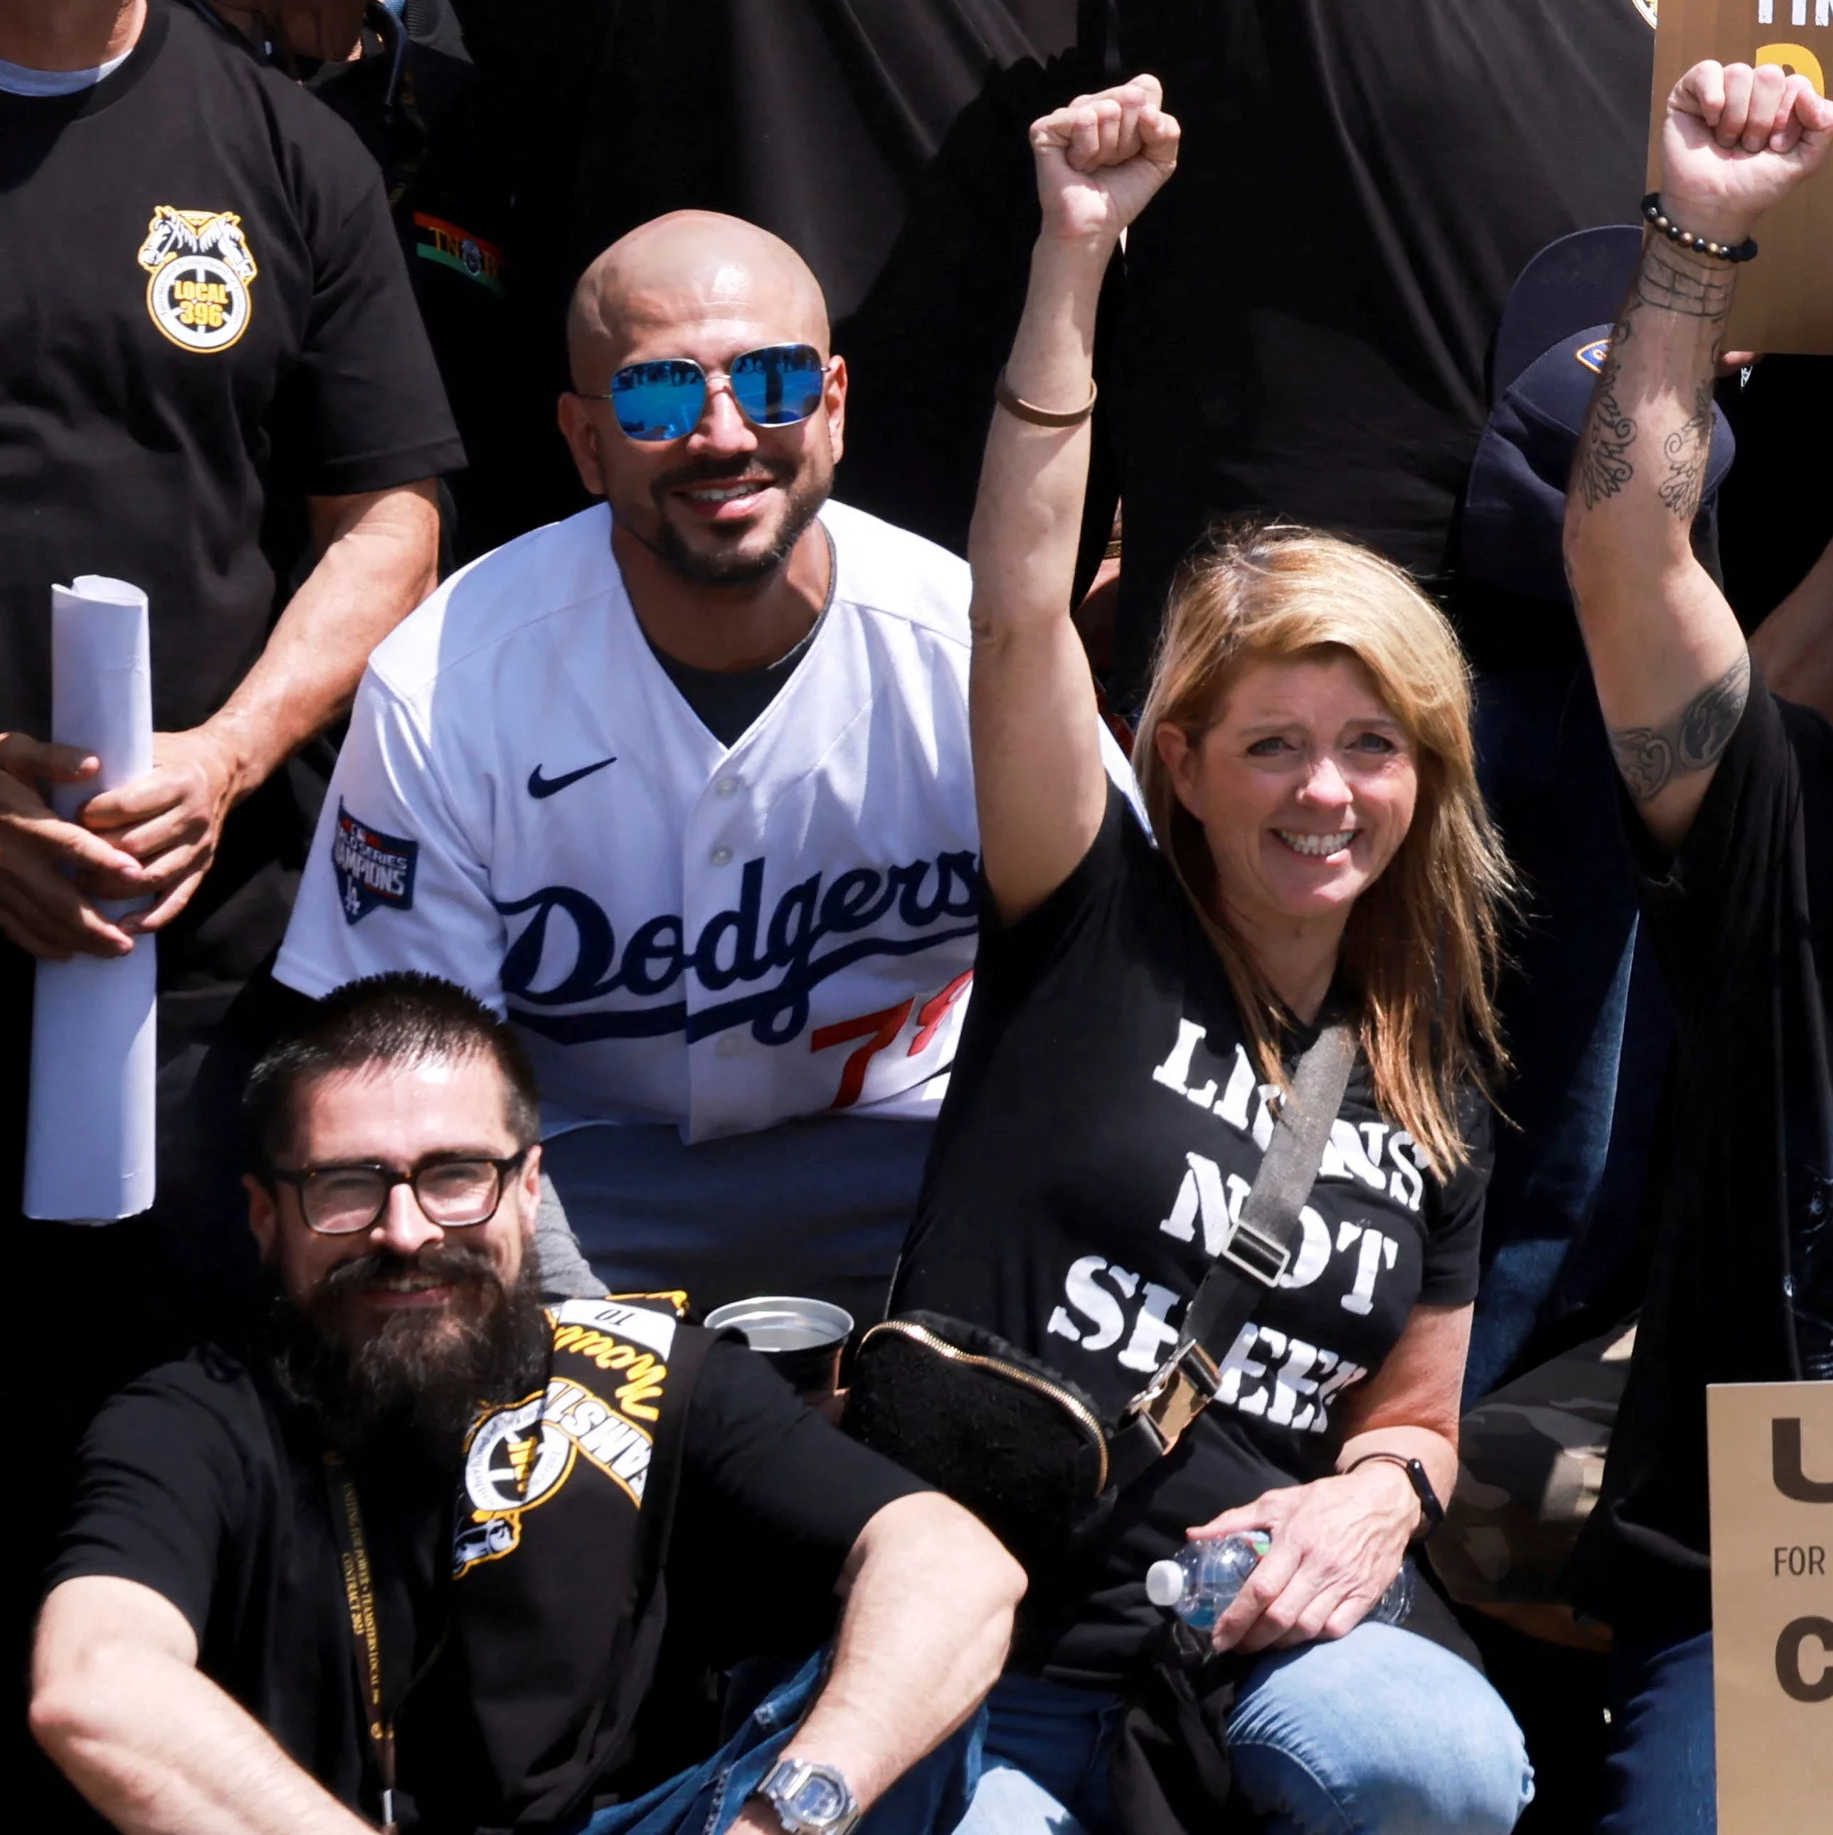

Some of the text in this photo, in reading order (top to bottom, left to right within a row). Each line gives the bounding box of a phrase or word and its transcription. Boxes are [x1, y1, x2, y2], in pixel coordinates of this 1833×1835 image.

[173, 280, 228, 304] LOCAL
[179, 301, 223, 328] 396
[497, 850, 980, 1044] Dodgers
[342, 1553, 361, 1607] CONTRACT
[1774, 1546, 1825, 1577] FOR
[355, 1547, 370, 1585] POWER
[368, 1647, 379, 1685] LOCAL
